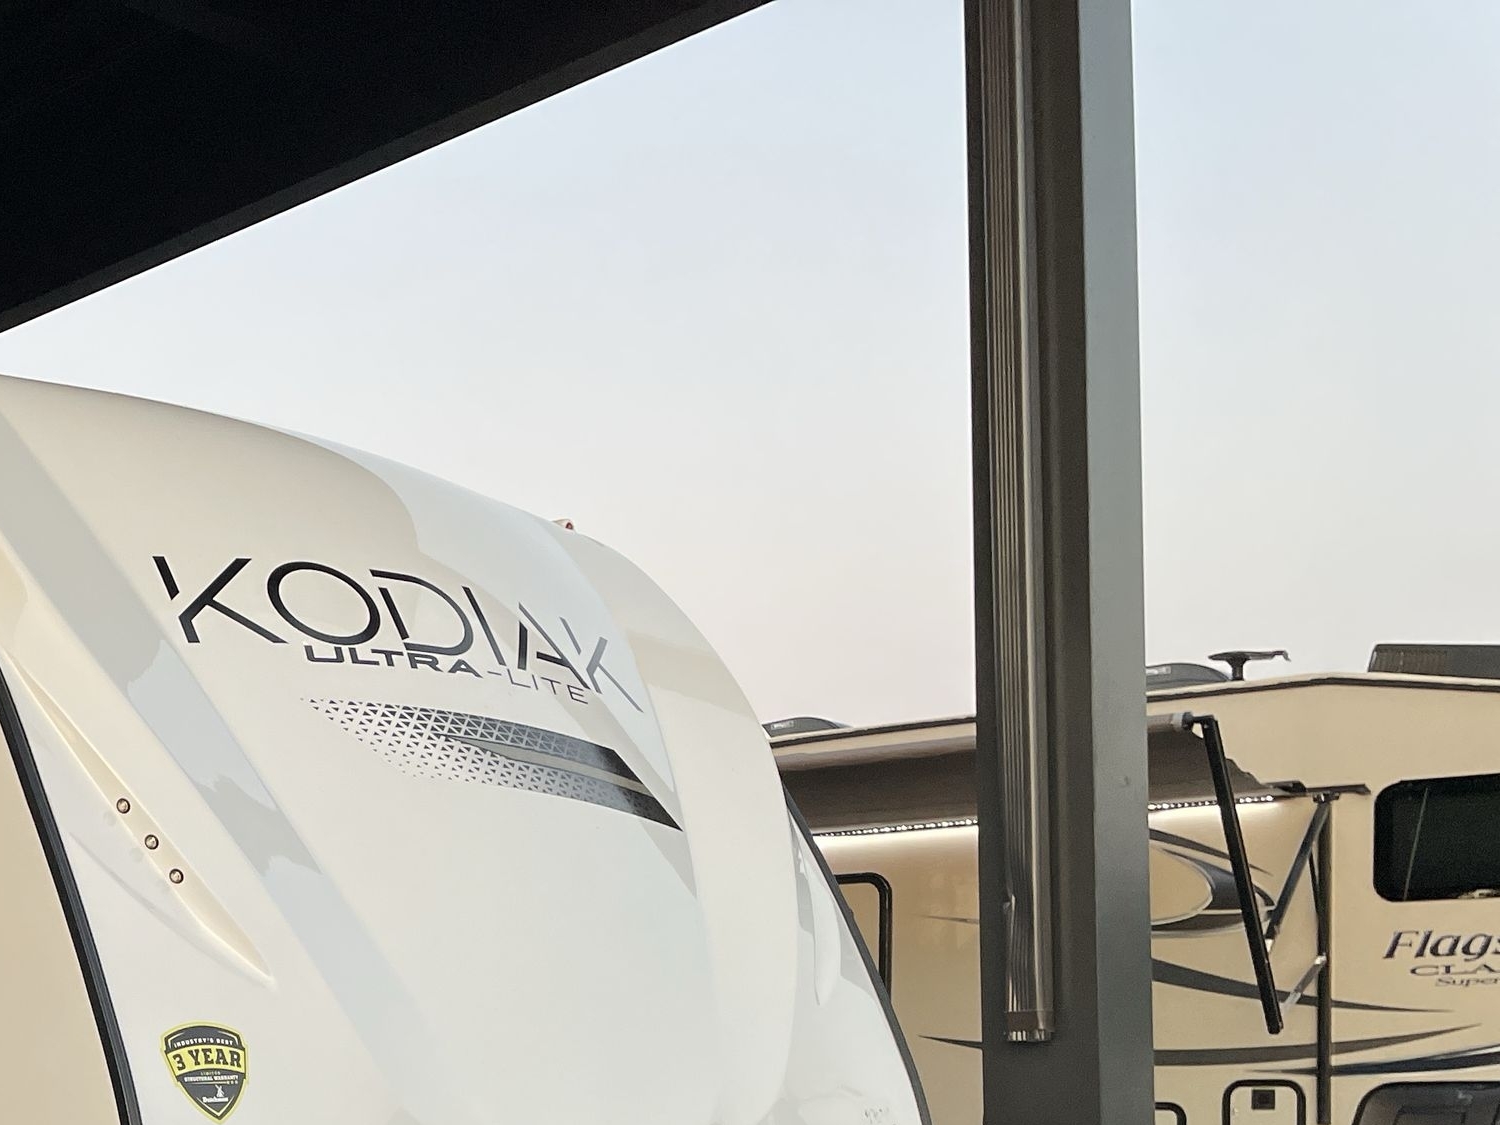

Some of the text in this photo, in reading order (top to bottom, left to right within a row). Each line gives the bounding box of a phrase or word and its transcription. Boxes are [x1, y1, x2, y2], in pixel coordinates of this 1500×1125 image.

[152, 556, 644, 712] KODIAK
[302, 645, 589, 705] ULTRA-LITE
[172, 1048, 242, 1071] 3 YEAR
